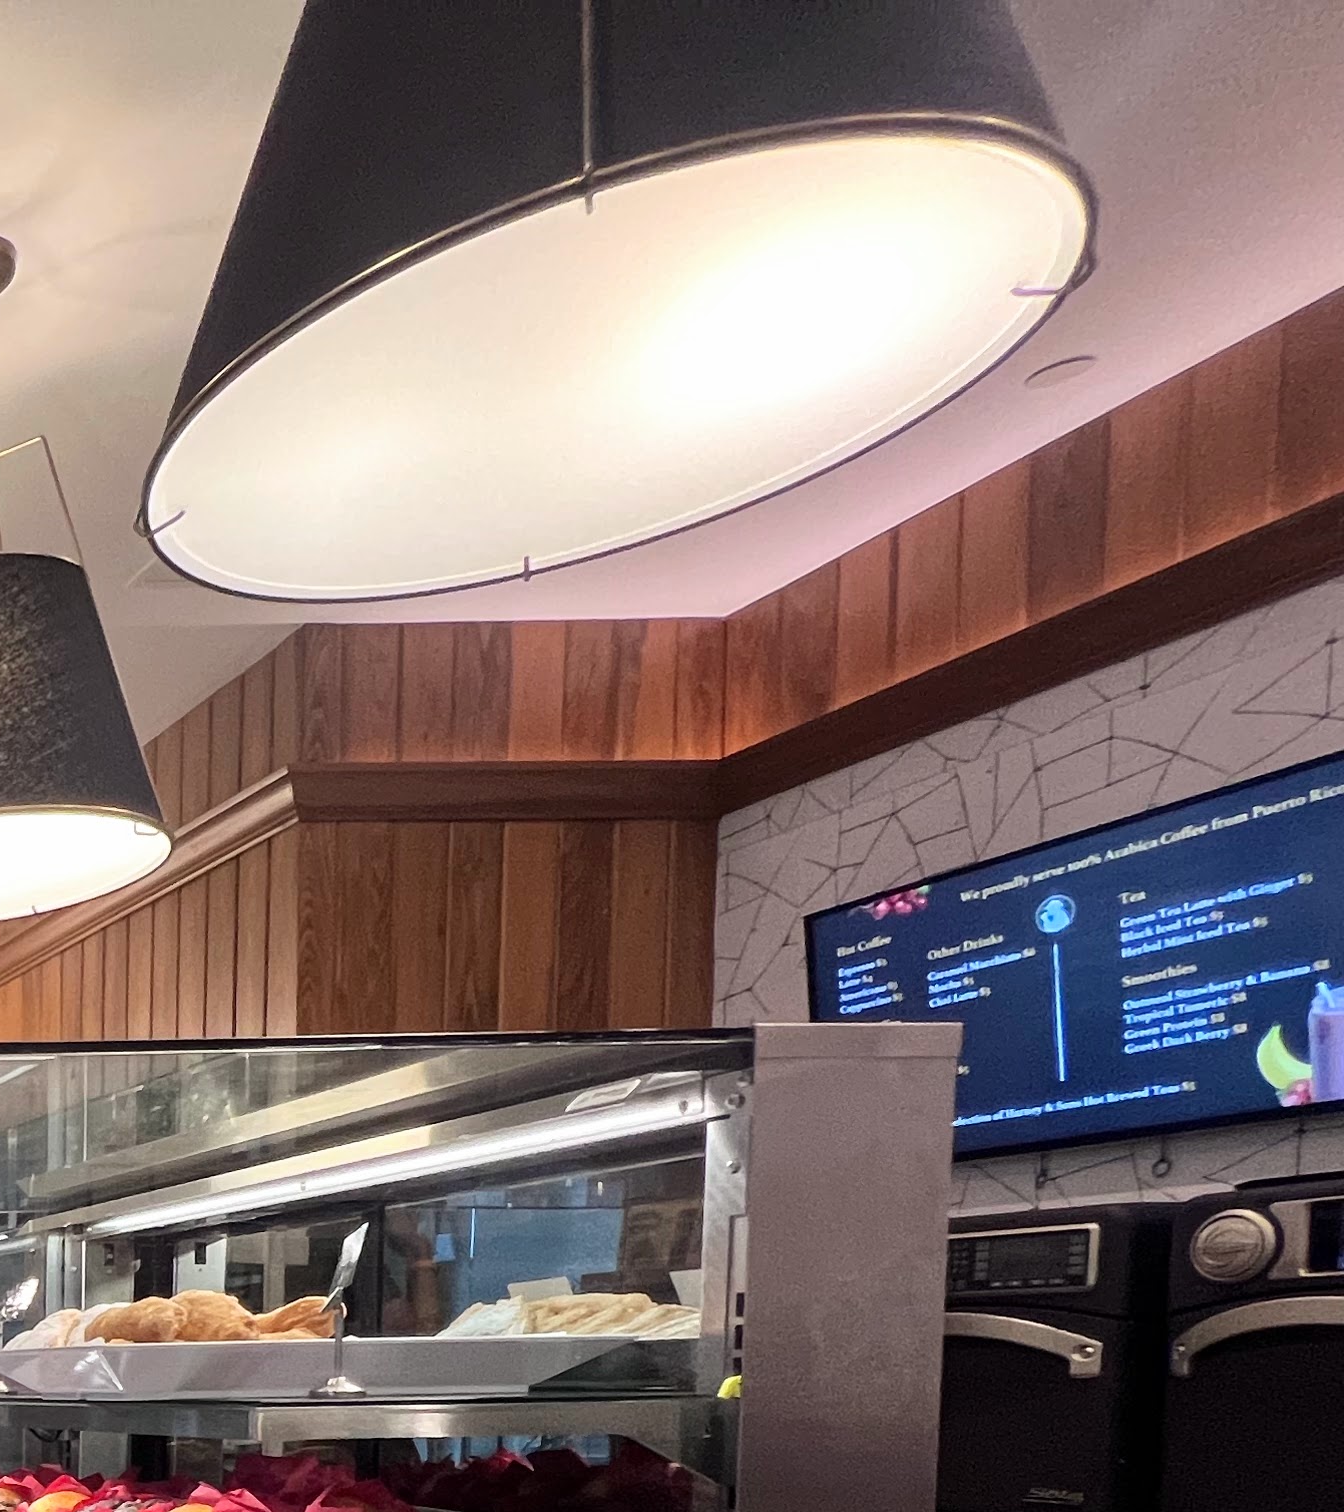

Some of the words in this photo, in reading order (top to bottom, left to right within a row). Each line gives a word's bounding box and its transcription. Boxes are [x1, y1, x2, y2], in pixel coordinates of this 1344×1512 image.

[1104, 838, 1159, 863] Arabica
[1160, 823, 1209, 845] Coffee
[1211, 810, 1249, 831] from
[1252, 794, 1307, 819] Puerto
[963, 934, 1004, 952] Drinks
[1121, 963, 1198, 988] Smoothies
